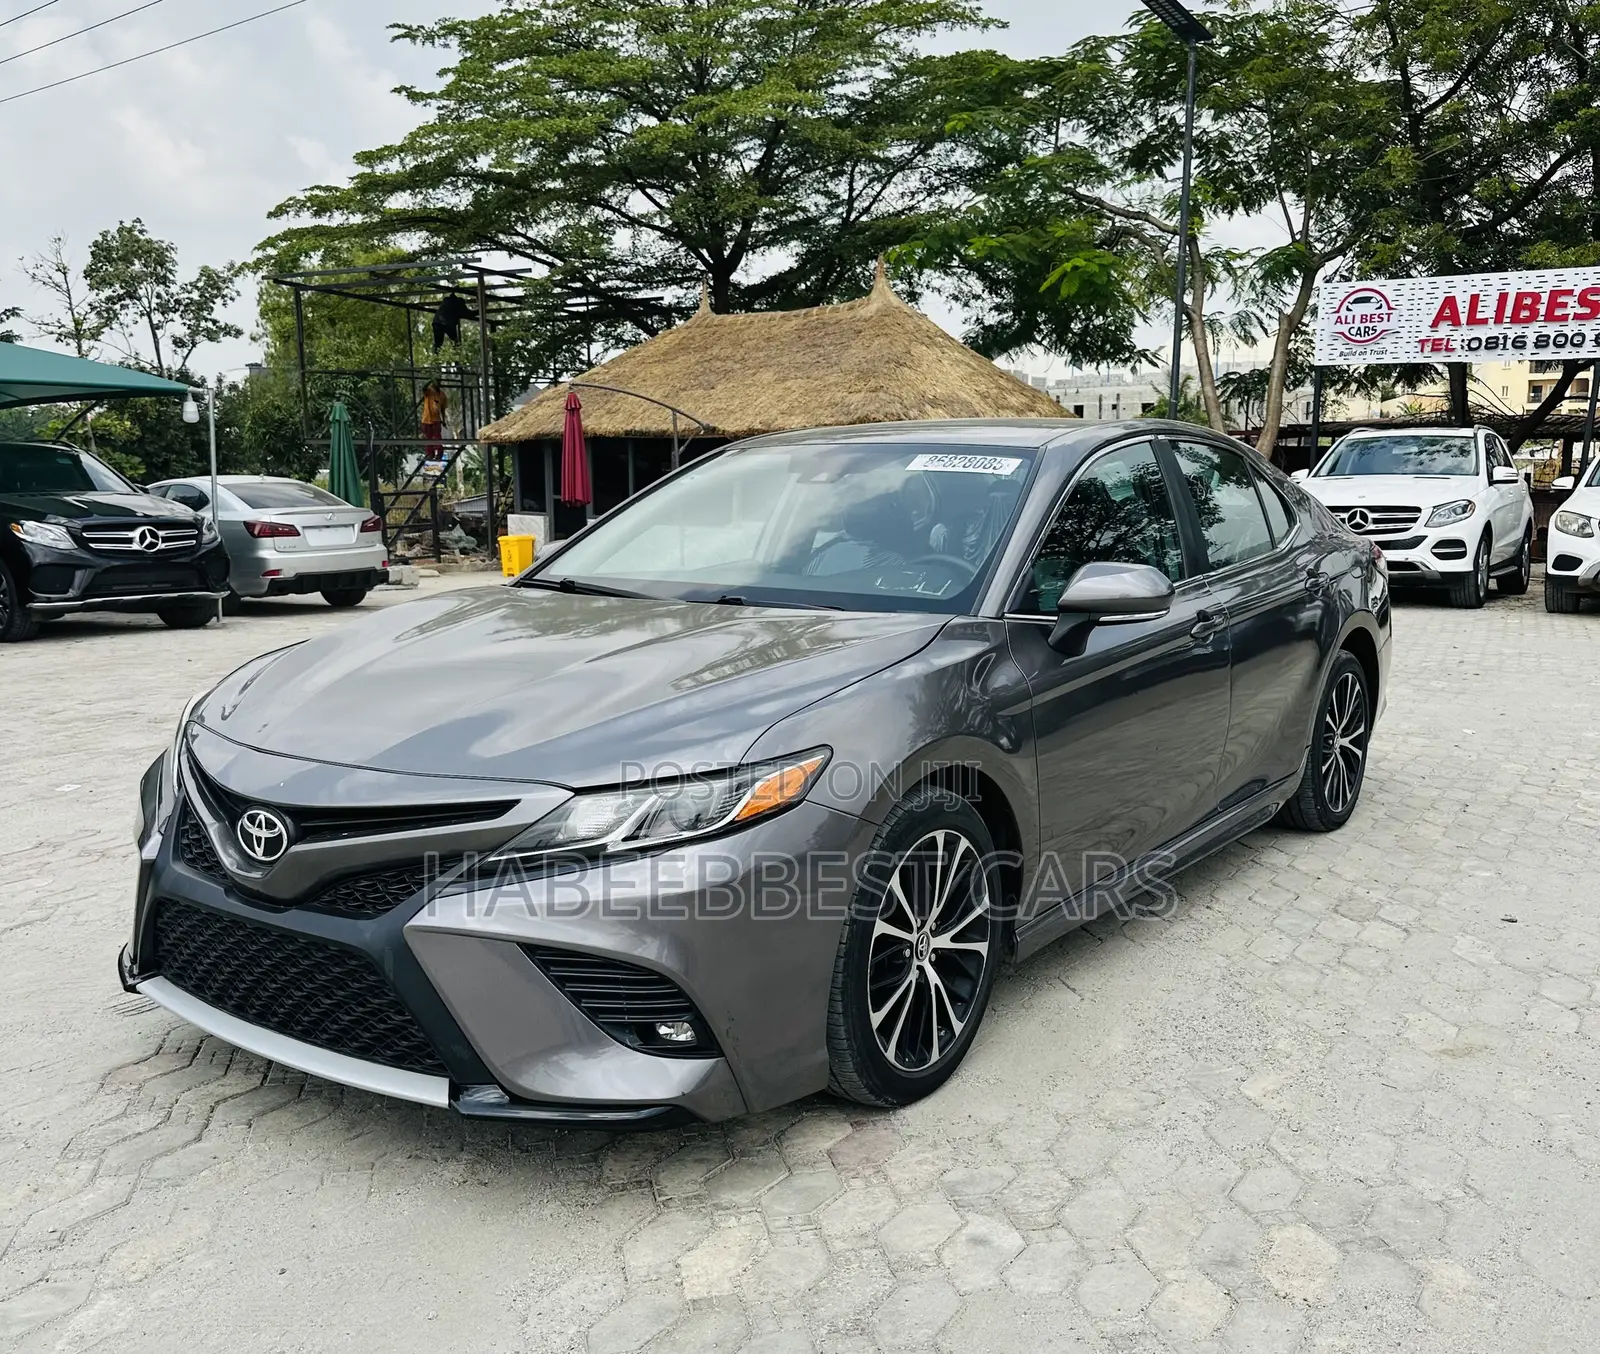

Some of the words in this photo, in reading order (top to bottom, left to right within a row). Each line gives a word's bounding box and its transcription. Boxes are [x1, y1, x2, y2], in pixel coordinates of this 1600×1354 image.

[1334, 314, 1356, 326] ALI
[1360, 312, 1393, 324] BEST
[1348, 325, 1378, 338] CARS
[1339, 350, 1358, 358] Build
